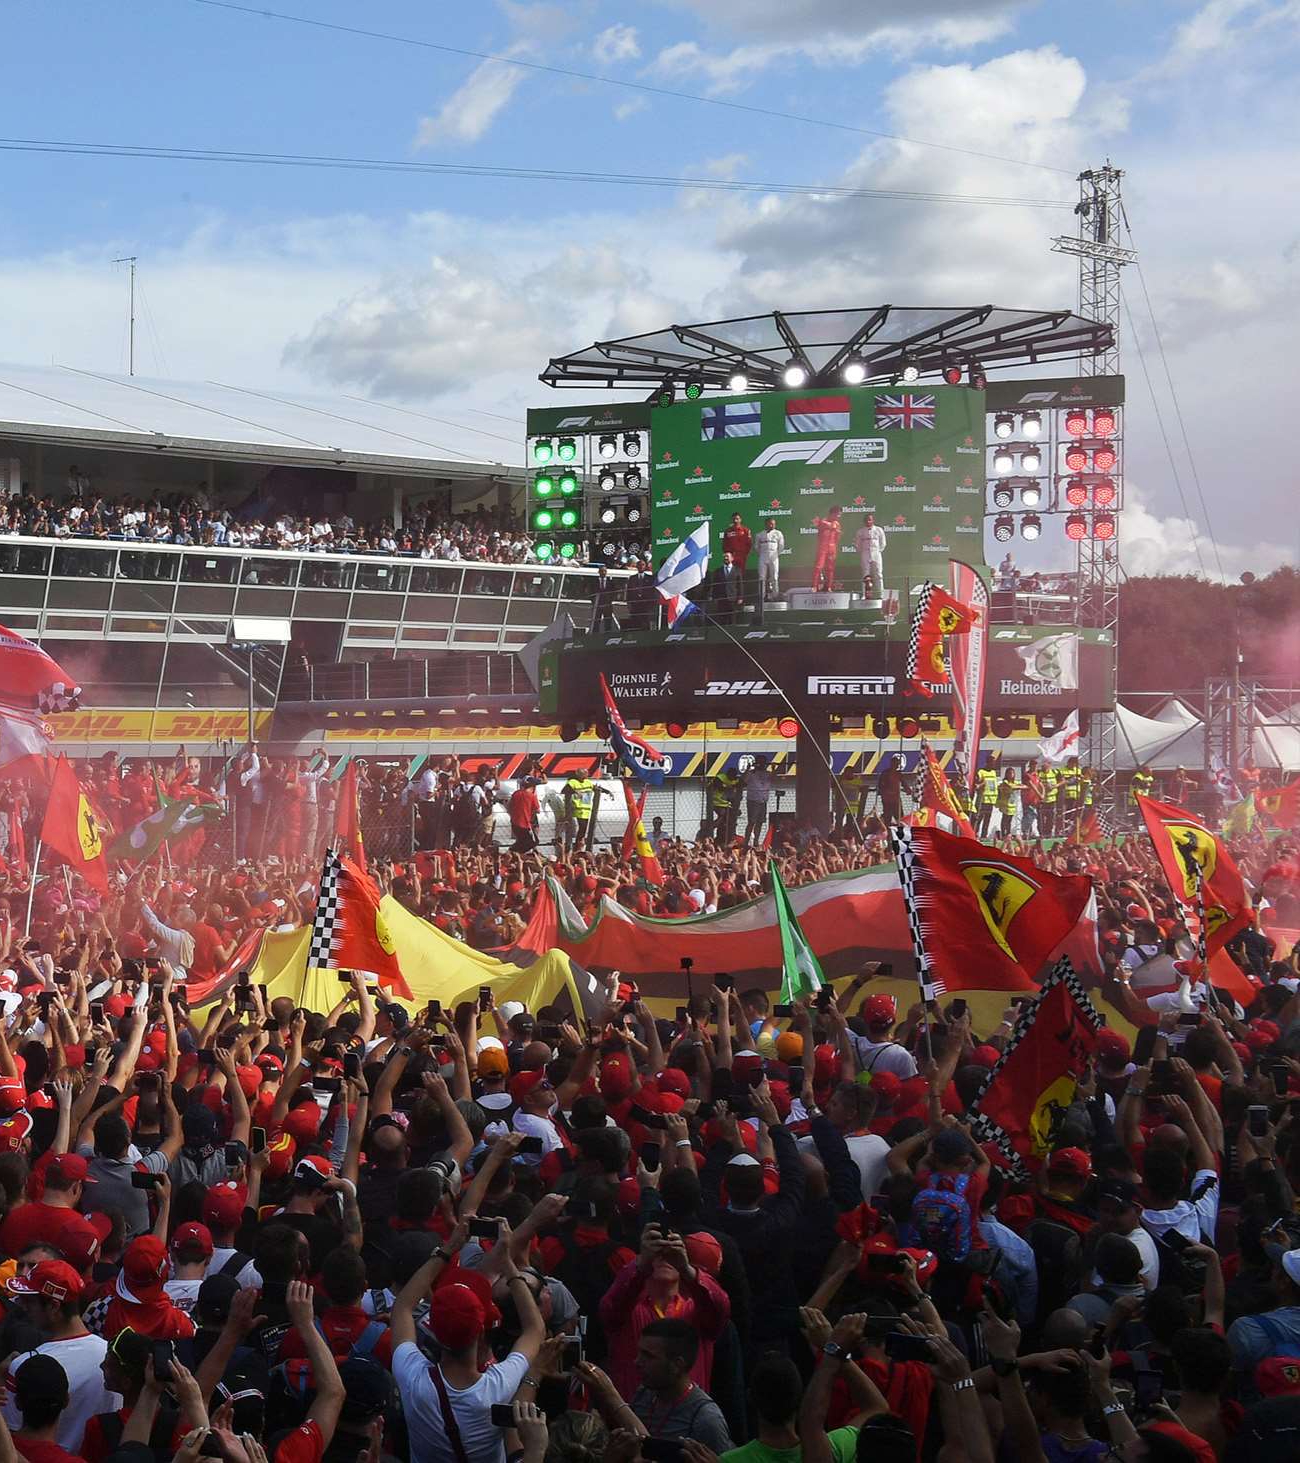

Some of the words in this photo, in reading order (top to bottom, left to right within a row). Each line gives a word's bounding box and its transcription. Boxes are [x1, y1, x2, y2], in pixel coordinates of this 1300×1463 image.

[748, 439, 845, 468] F1
[610, 673, 657, 687] JOHNNIE
[706, 681, 771, 695] DHL
[808, 676, 896, 695] PIRELLI
[613, 687, 657, 698] WALKER
[50, 716, 125, 738] DHL
[172, 716, 248, 737] DHL
